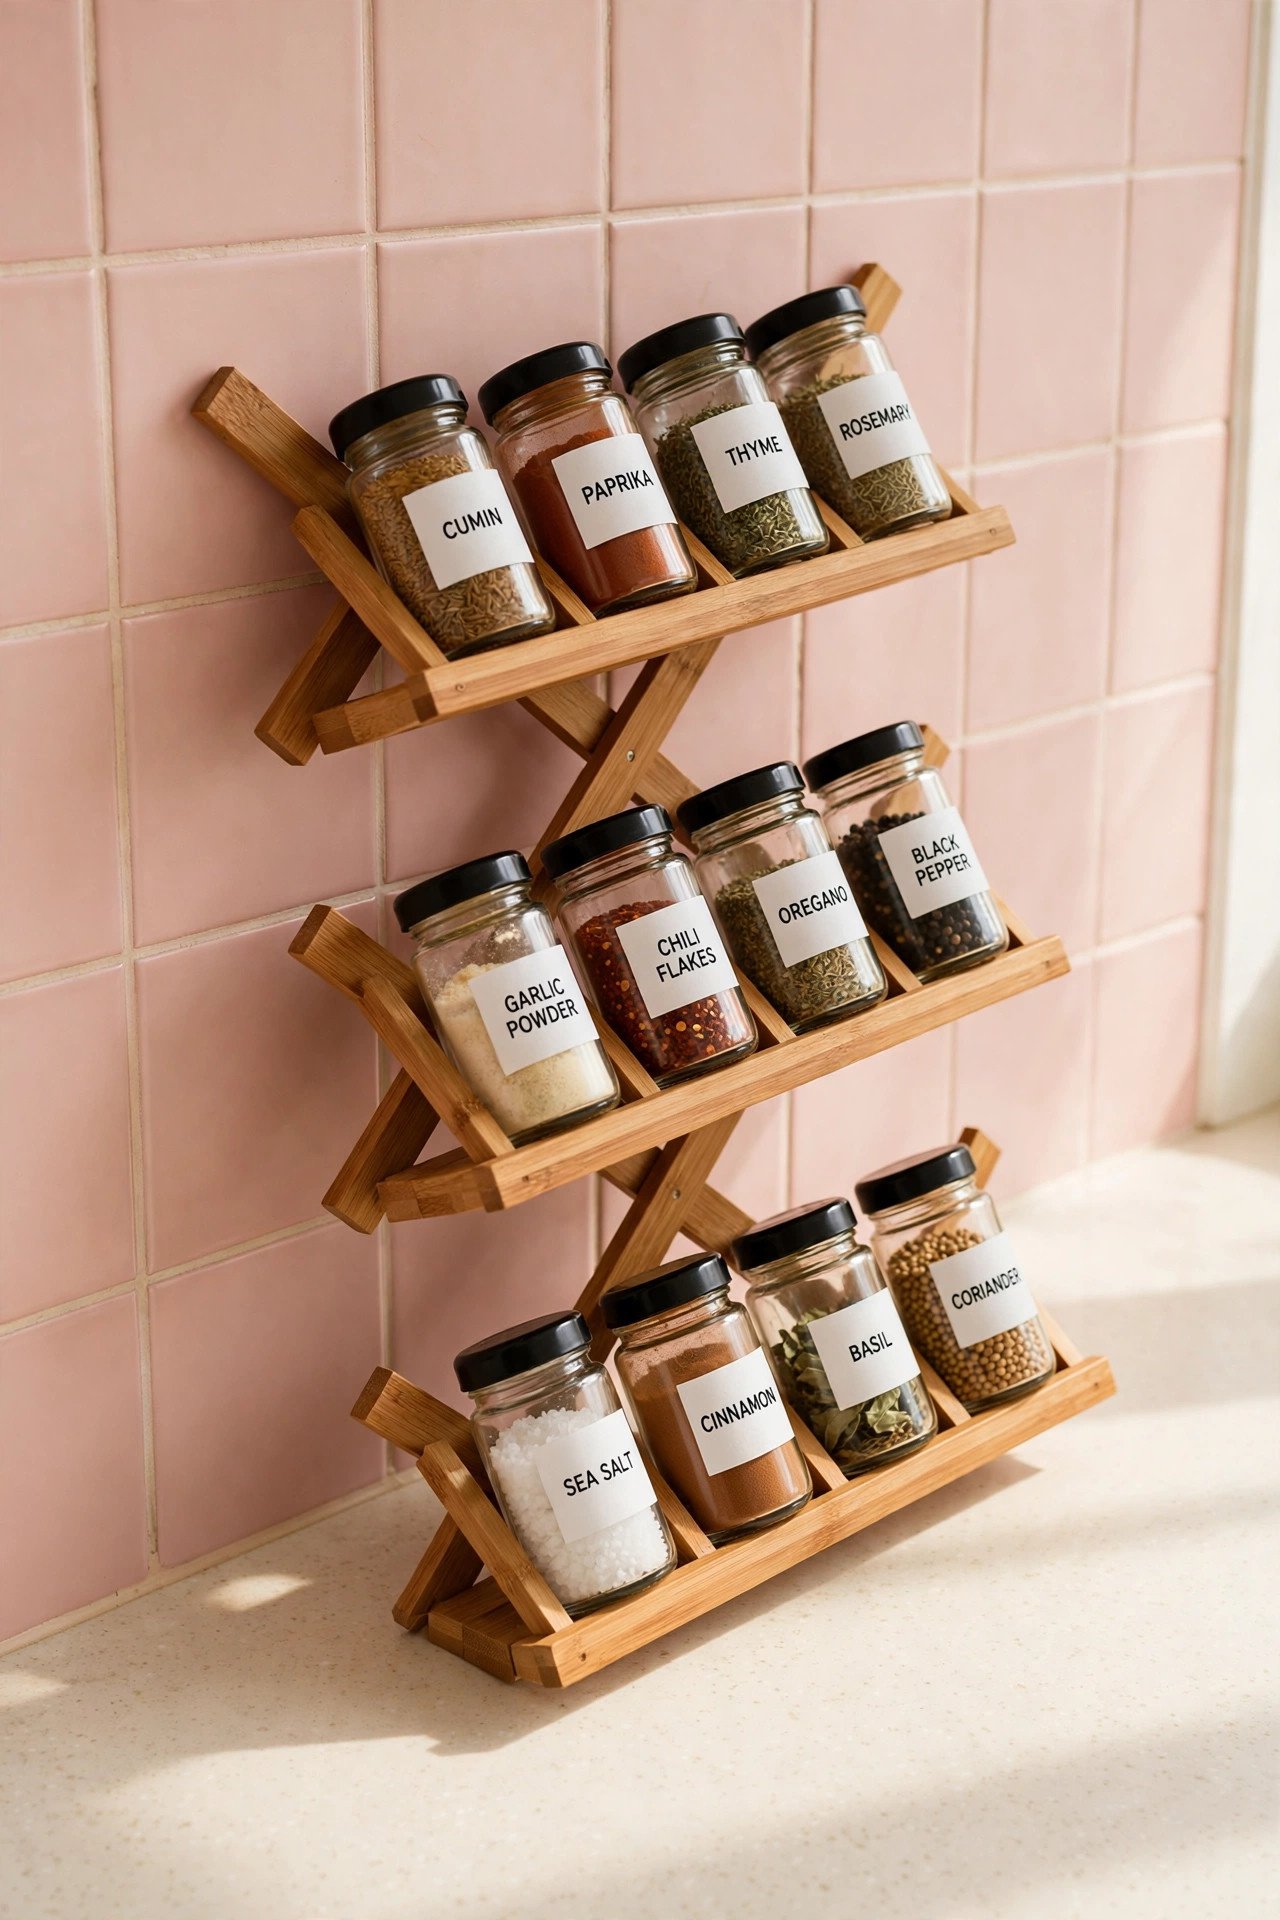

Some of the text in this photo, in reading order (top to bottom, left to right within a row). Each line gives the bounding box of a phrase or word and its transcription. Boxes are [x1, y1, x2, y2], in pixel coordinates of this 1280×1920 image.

[839, 403, 912, 441] ROSEMARY
[725, 436, 783, 466] THYME
[581, 469, 654, 505] PAPRIKA
[442, 507, 503, 539] CUMIN
[911, 834, 960, 864] BLACK
[914, 853, 972, 887] PEPPER
[778, 885, 848, 925] OREGANO
[657, 927, 701, 956] CHILI
[656, 947, 717, 982] FLAKES
[504, 977, 565, 1013] GARLIC
[506, 998, 579, 1039] POWDER
[951, 1267, 1021, 1310] CORIANDER
[848, 1332, 893, 1362] BASIL
[700, 1386, 777, 1433] CINNAMON
[563, 1451, 635, 1497] SEA SALT
